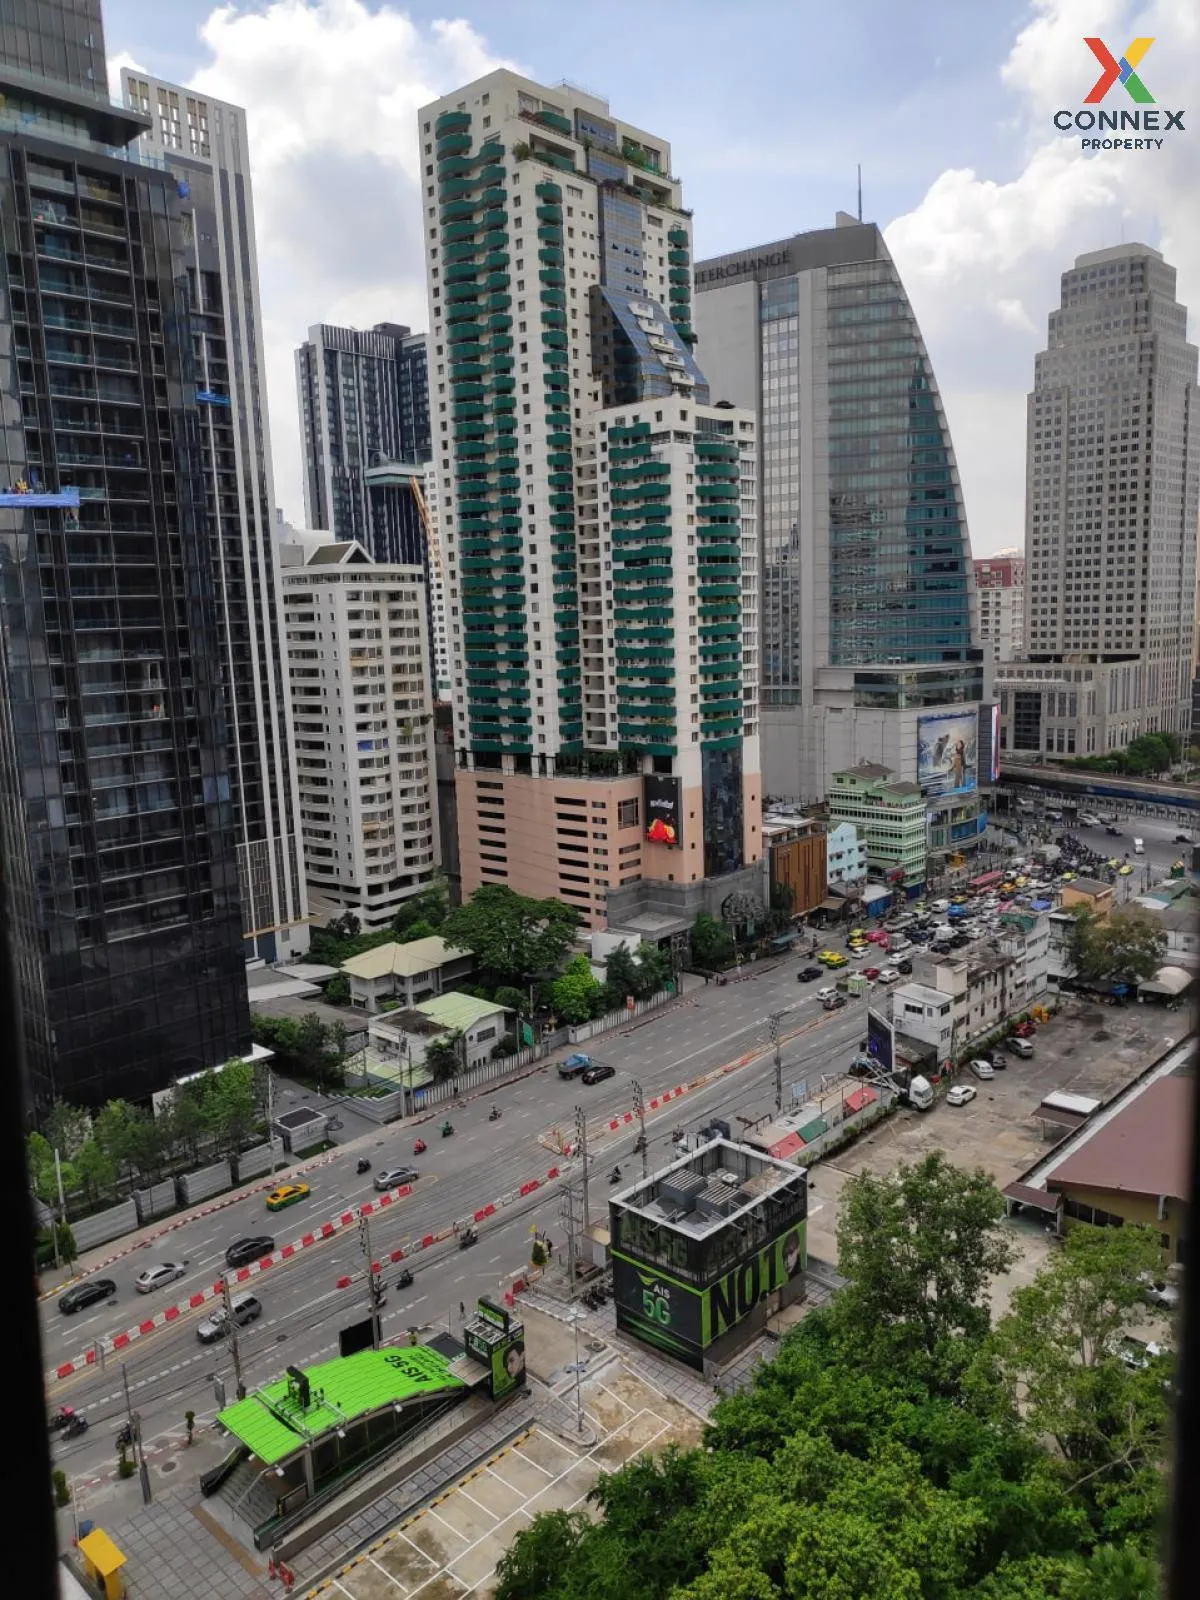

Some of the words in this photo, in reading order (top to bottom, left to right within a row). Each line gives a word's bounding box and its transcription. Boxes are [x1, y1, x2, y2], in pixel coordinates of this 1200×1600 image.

[653, 1284, 671, 1300] AIS
[642, 1289, 671, 1326] 5G
[400, 1366, 433, 1383] AIS
